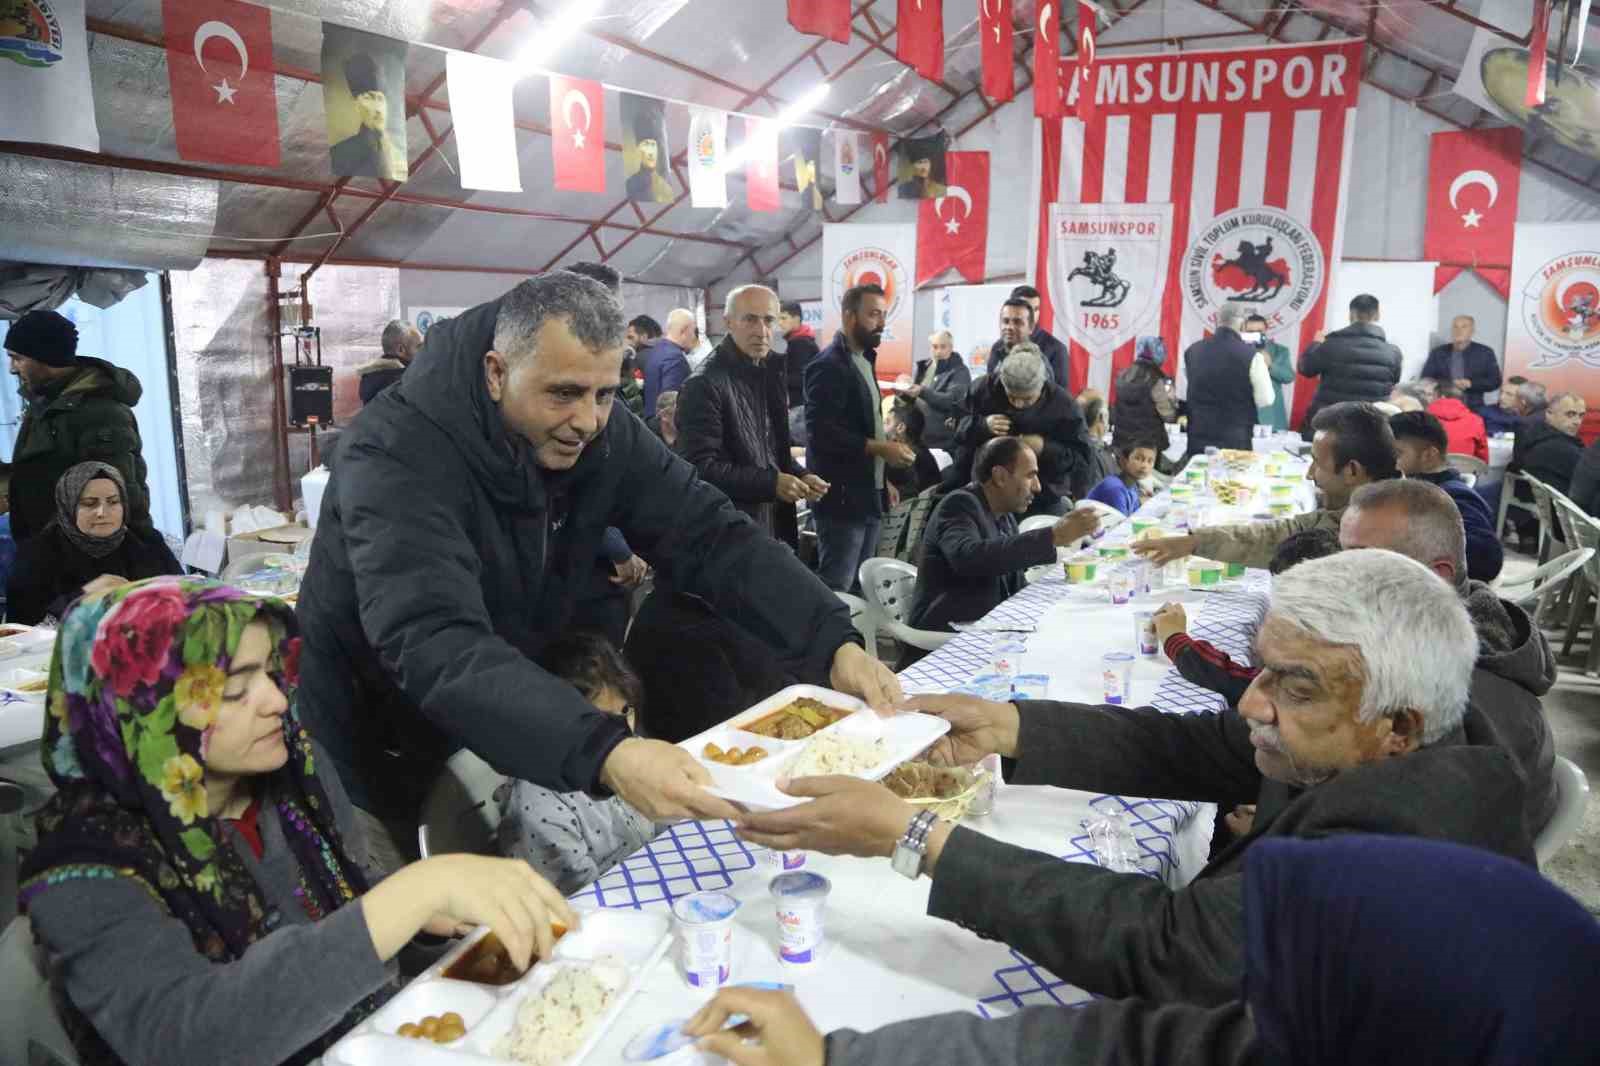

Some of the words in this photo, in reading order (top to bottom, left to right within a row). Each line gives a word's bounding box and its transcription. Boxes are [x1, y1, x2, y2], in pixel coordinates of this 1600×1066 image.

[1058, 53, 1347, 106] AMSUNSPOR
[1061, 221, 1156, 236] SAMSUNSPOR
[1189, 271, 1209, 309] SAMSUN
[1203, 217, 1241, 246] TOPLUM
[1289, 242, 1315, 312] FEDERASYONU
[1543, 256, 1600, 280] SAMSUNL
[1084, 313, 1119, 329] 1965
